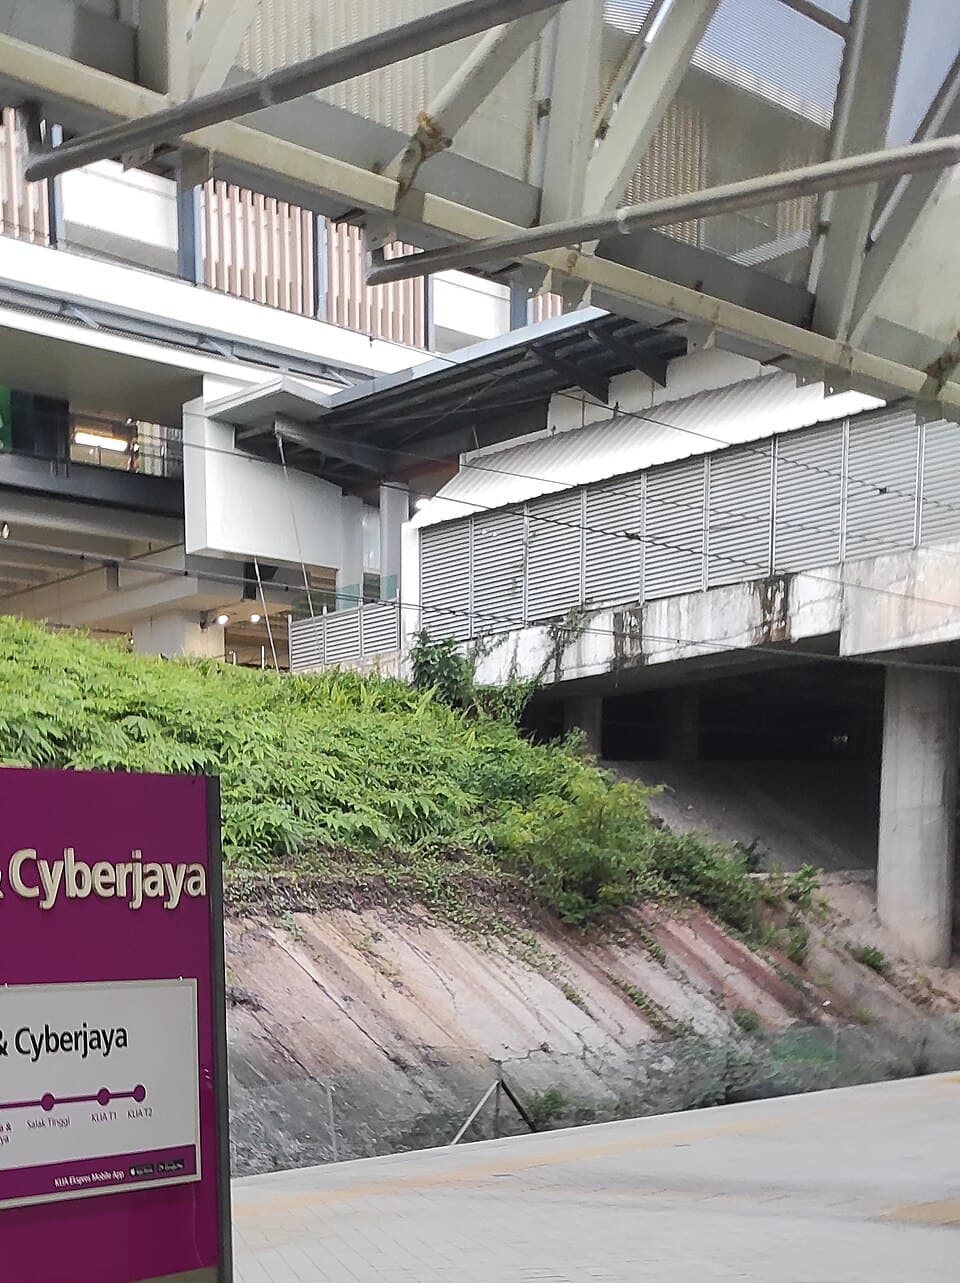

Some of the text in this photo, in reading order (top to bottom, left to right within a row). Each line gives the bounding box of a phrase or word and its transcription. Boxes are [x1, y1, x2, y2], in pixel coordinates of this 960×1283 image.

[8, 847, 207, 910] Cyberjaya
[15, 1022, 128, 1062] Cyberjaya
[5, 1122, 12, 1132] &
